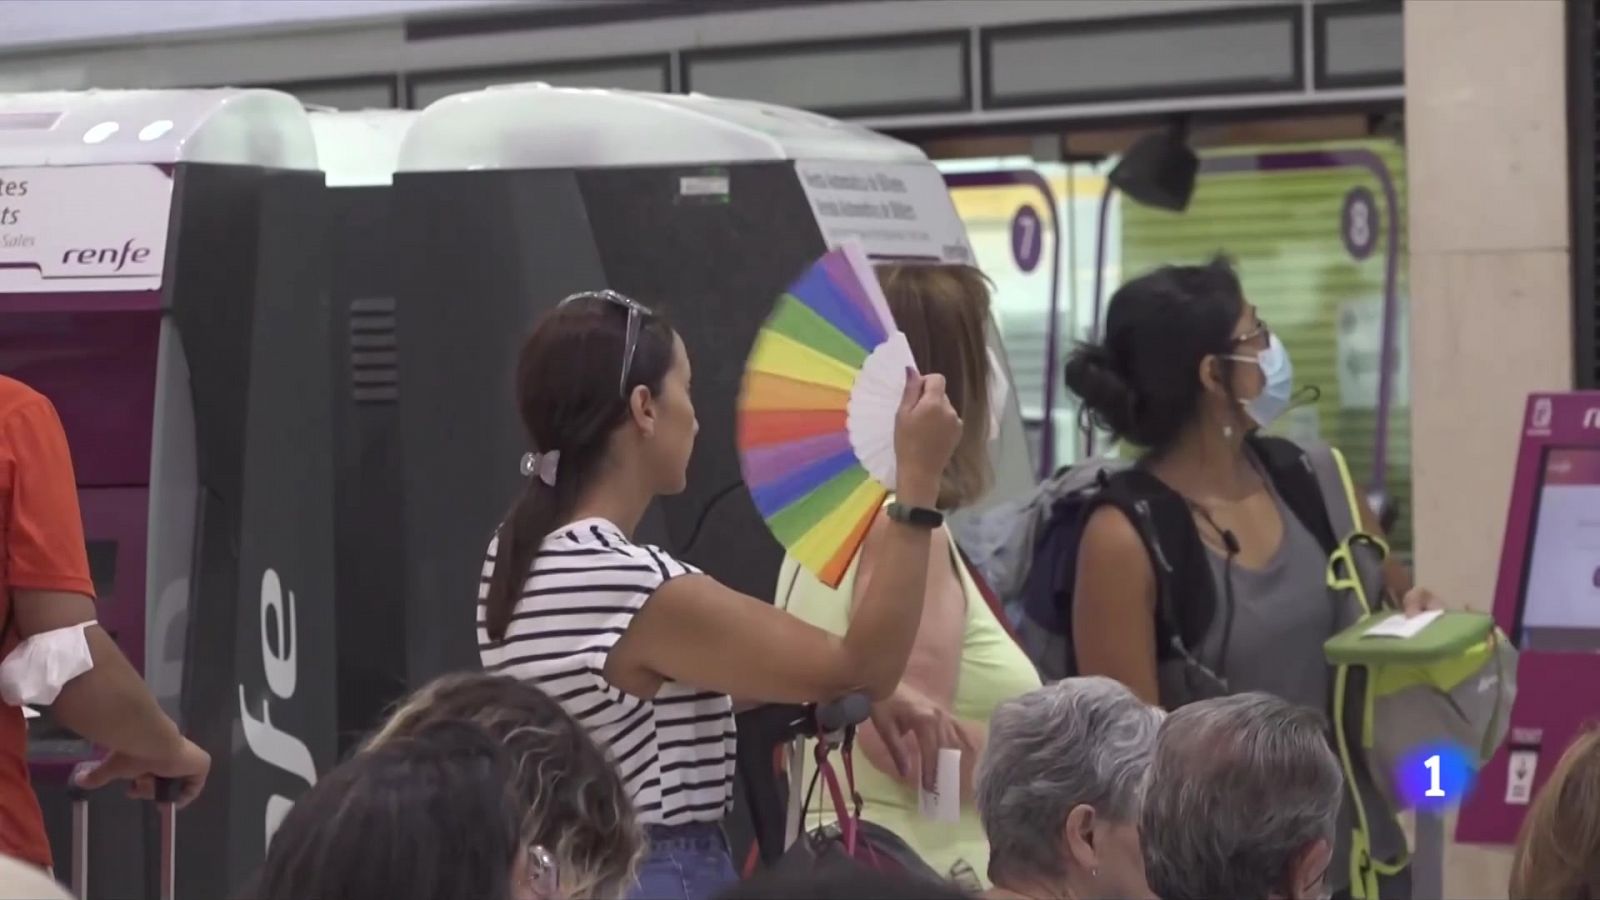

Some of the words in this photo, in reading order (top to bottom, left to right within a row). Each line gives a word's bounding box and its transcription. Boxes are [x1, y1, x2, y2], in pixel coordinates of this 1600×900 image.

[1017, 214, 1034, 261] 7
[1349, 200, 1371, 247] 8
[61, 237, 151, 272] renfe
